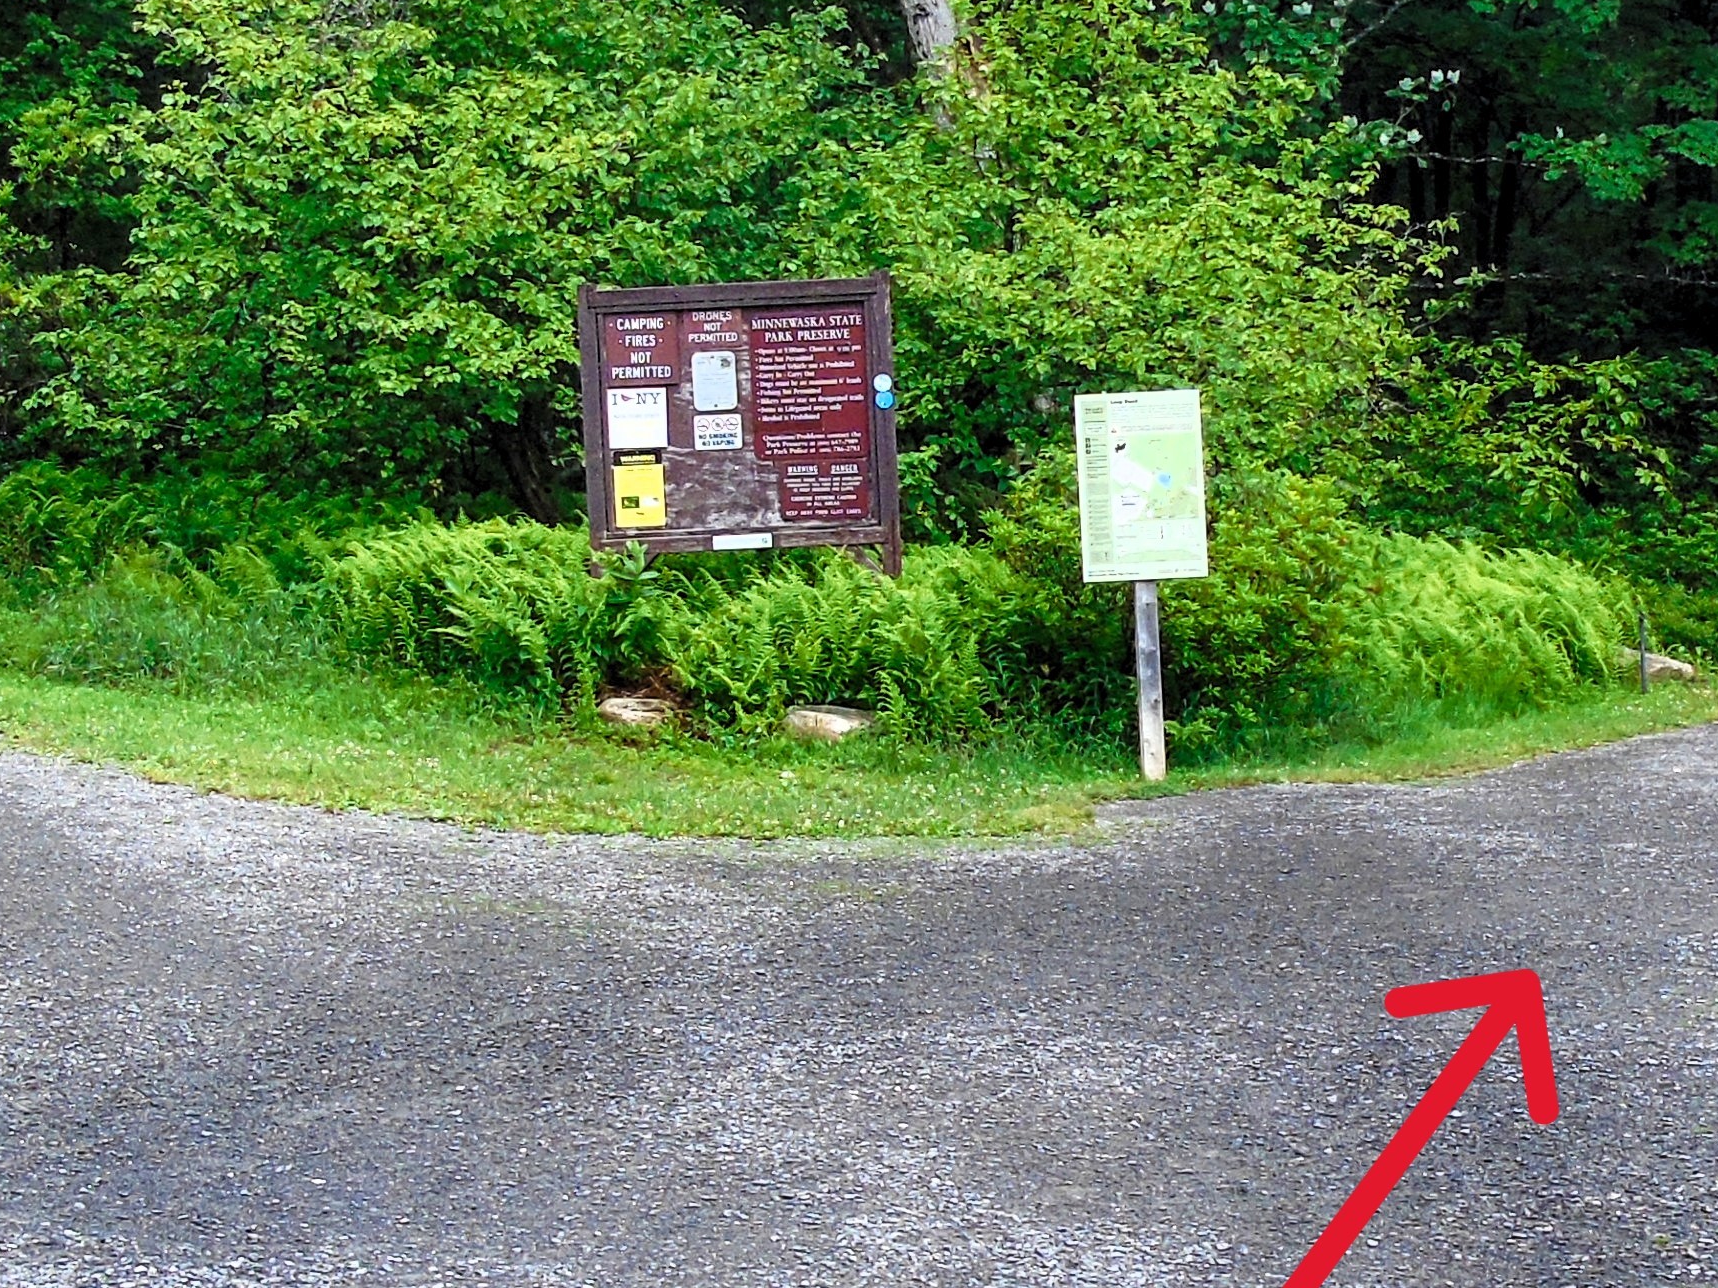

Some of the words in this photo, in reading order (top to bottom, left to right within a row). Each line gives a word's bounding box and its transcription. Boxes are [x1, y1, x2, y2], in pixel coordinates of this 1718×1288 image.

[693, 311, 732, 322] DRONES
[752, 317, 825, 330] MINNEWASKA
[829, 314, 862, 326] STATE
[617, 317, 663, 330] CAMPING
[704, 322, 722, 332] NOT
[625, 334, 655, 347] FIRES
[688, 332, 737, 342] PERMITTED
[765, 331, 793, 343] PARK
[797, 328, 850, 341] PRESERVE
[630, 351, 651, 364] NOT
[612, 365, 671, 379] PERMITTED
[636, 393, 661, 404] NY
